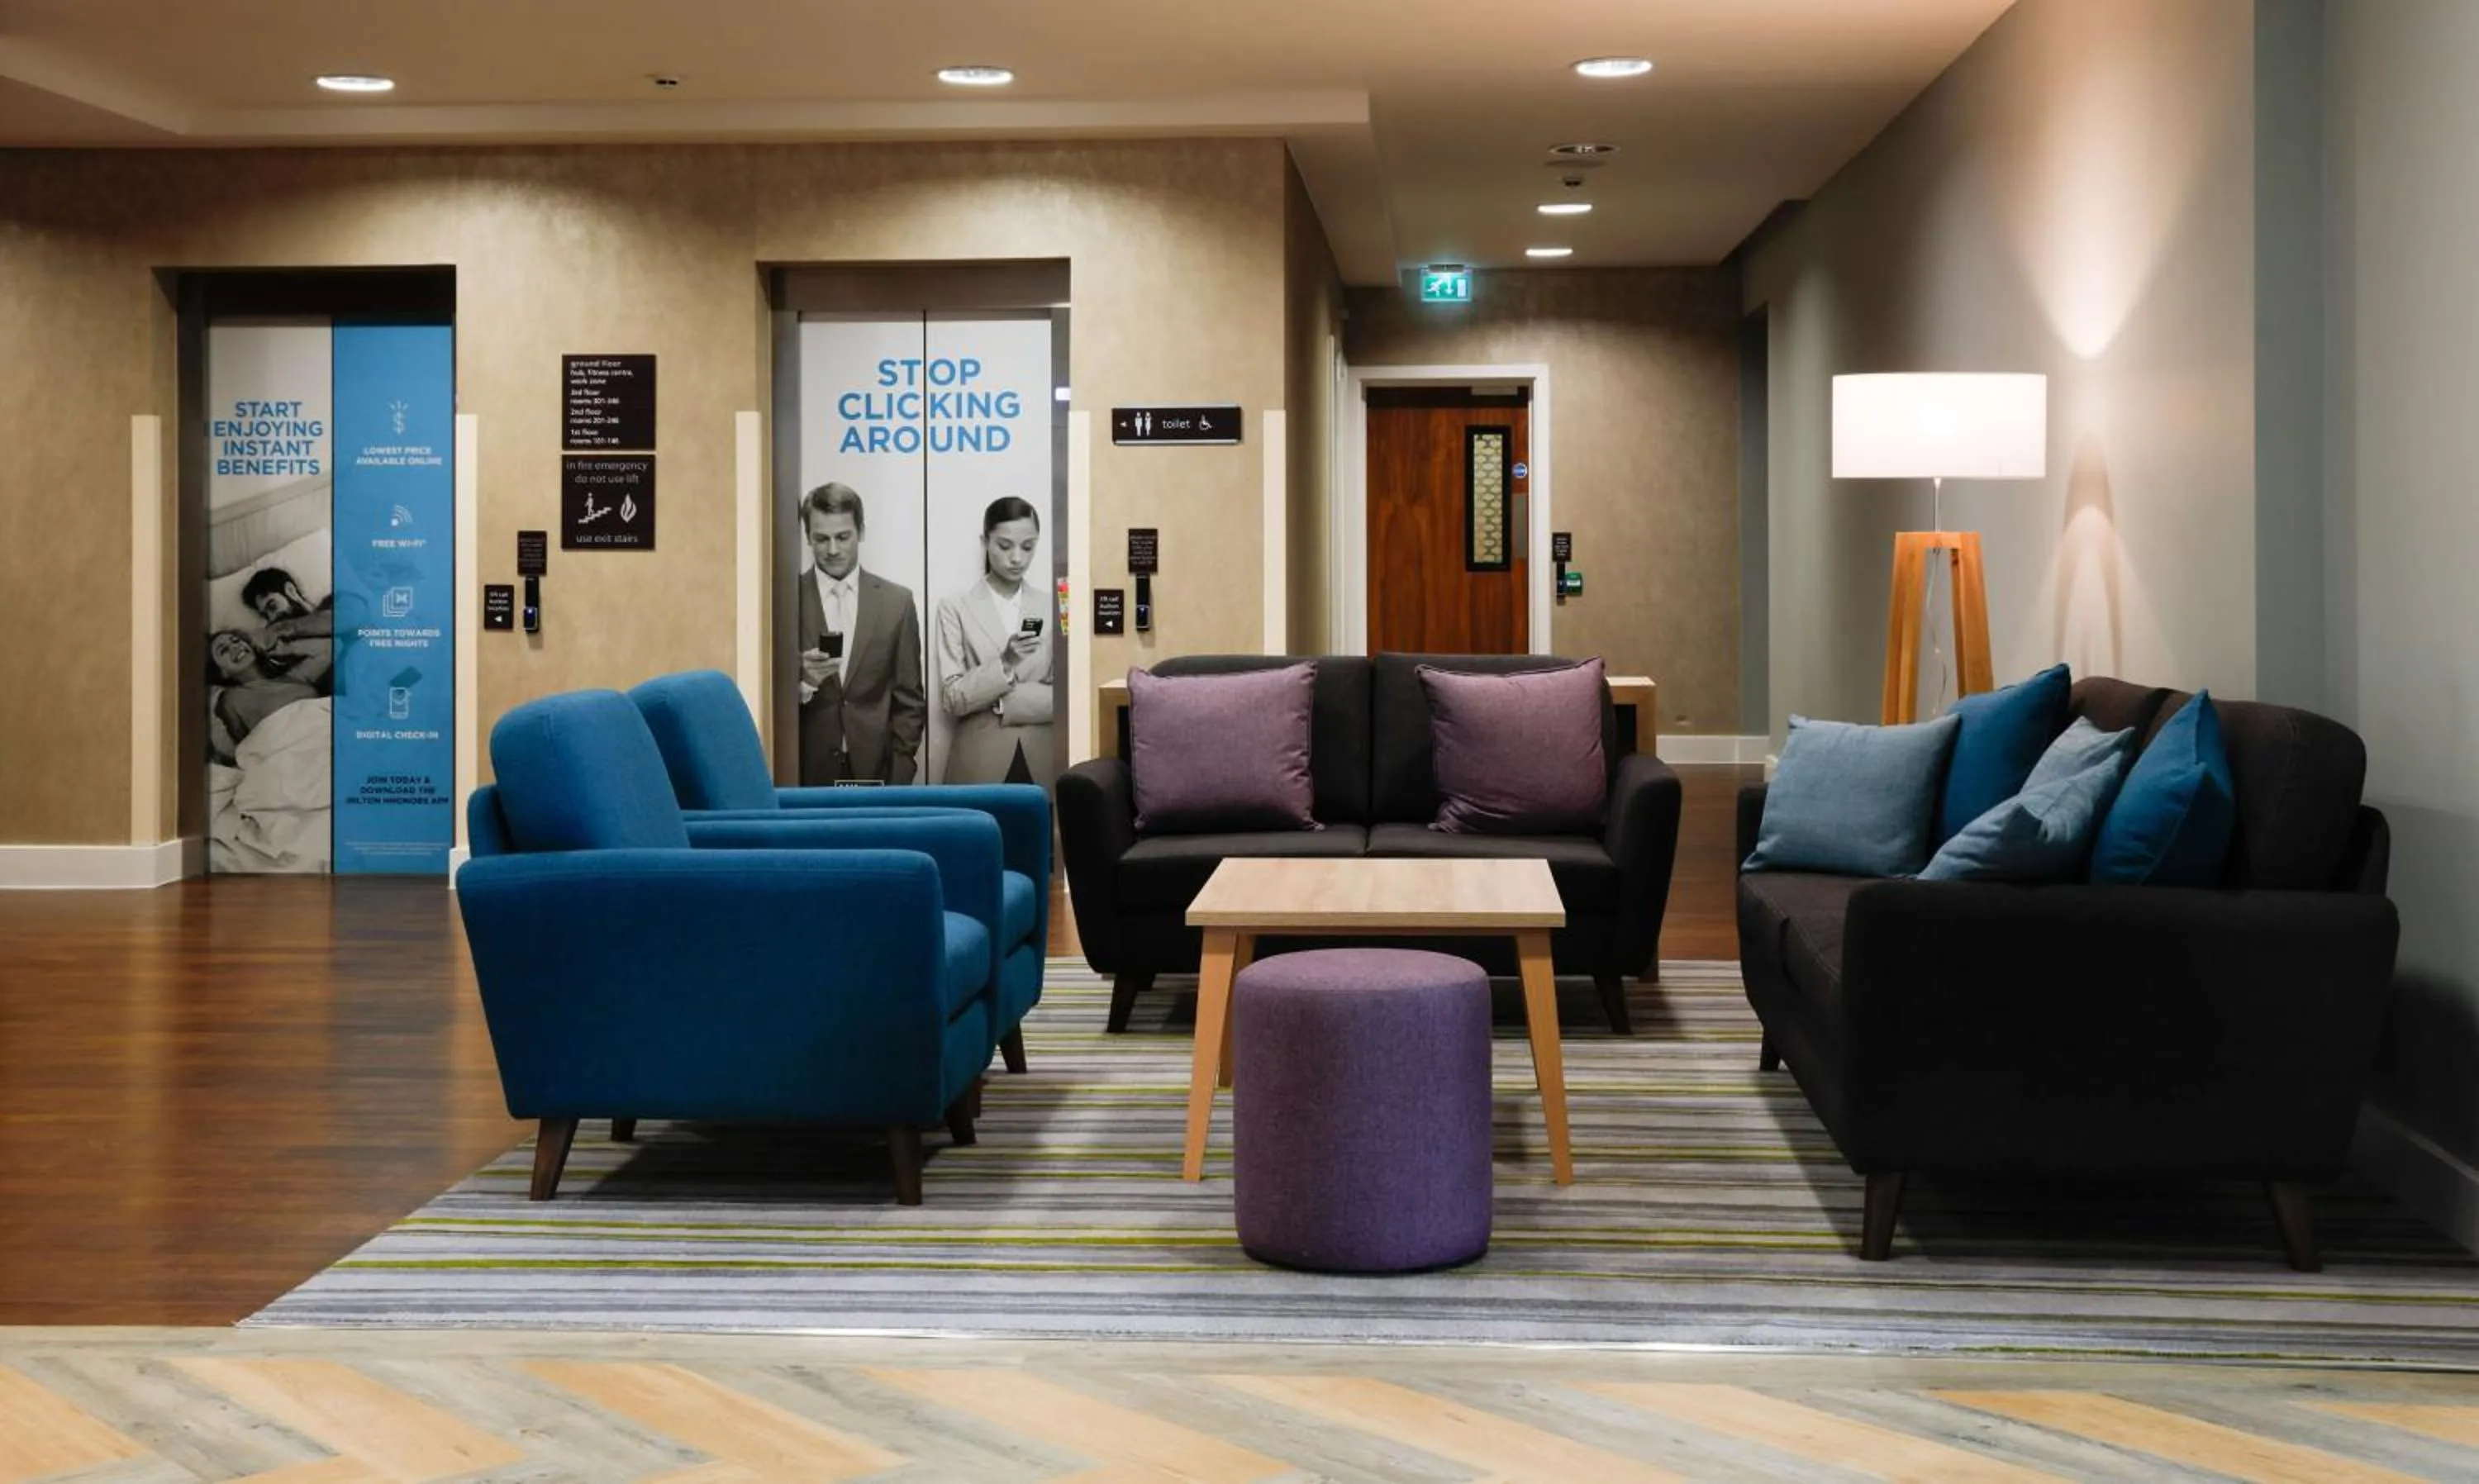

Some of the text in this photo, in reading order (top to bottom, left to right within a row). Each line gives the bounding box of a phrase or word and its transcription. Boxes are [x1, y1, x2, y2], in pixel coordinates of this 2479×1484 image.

[570, 360, 600, 369] ground
[878, 358, 981, 386] STOP
[236, 401, 302, 418] START
[838, 391, 1021, 420] CLICKING
[213, 421, 323, 437] ENJOYING
[1162, 419, 1190, 429] toilet
[840, 425, 1011, 454] AROUND
[224, 439, 314, 455] INSTANT
[364, 446, 431, 454] LOWEST PRICE
[356, 457, 442, 465] AVAILABLE ONLINE
[566, 460, 647, 472] in fire emergency
[216, 459, 320, 475] BENEFITS
[574, 473, 640, 483] do not use lift
[371, 540, 395, 548] FREE
[576, 535, 638, 543] use exit stairs
[358, 629, 440, 637] POINTS TOWARDS
[369, 639, 429, 648] FREE NIGHTS
[356, 730, 439, 740] DIGITAL CHECK-IN
[366, 776, 388, 784] JOIN
[390, 776, 421, 784] TODAY
[359, 786, 435, 794] DOWNLOAD THE
